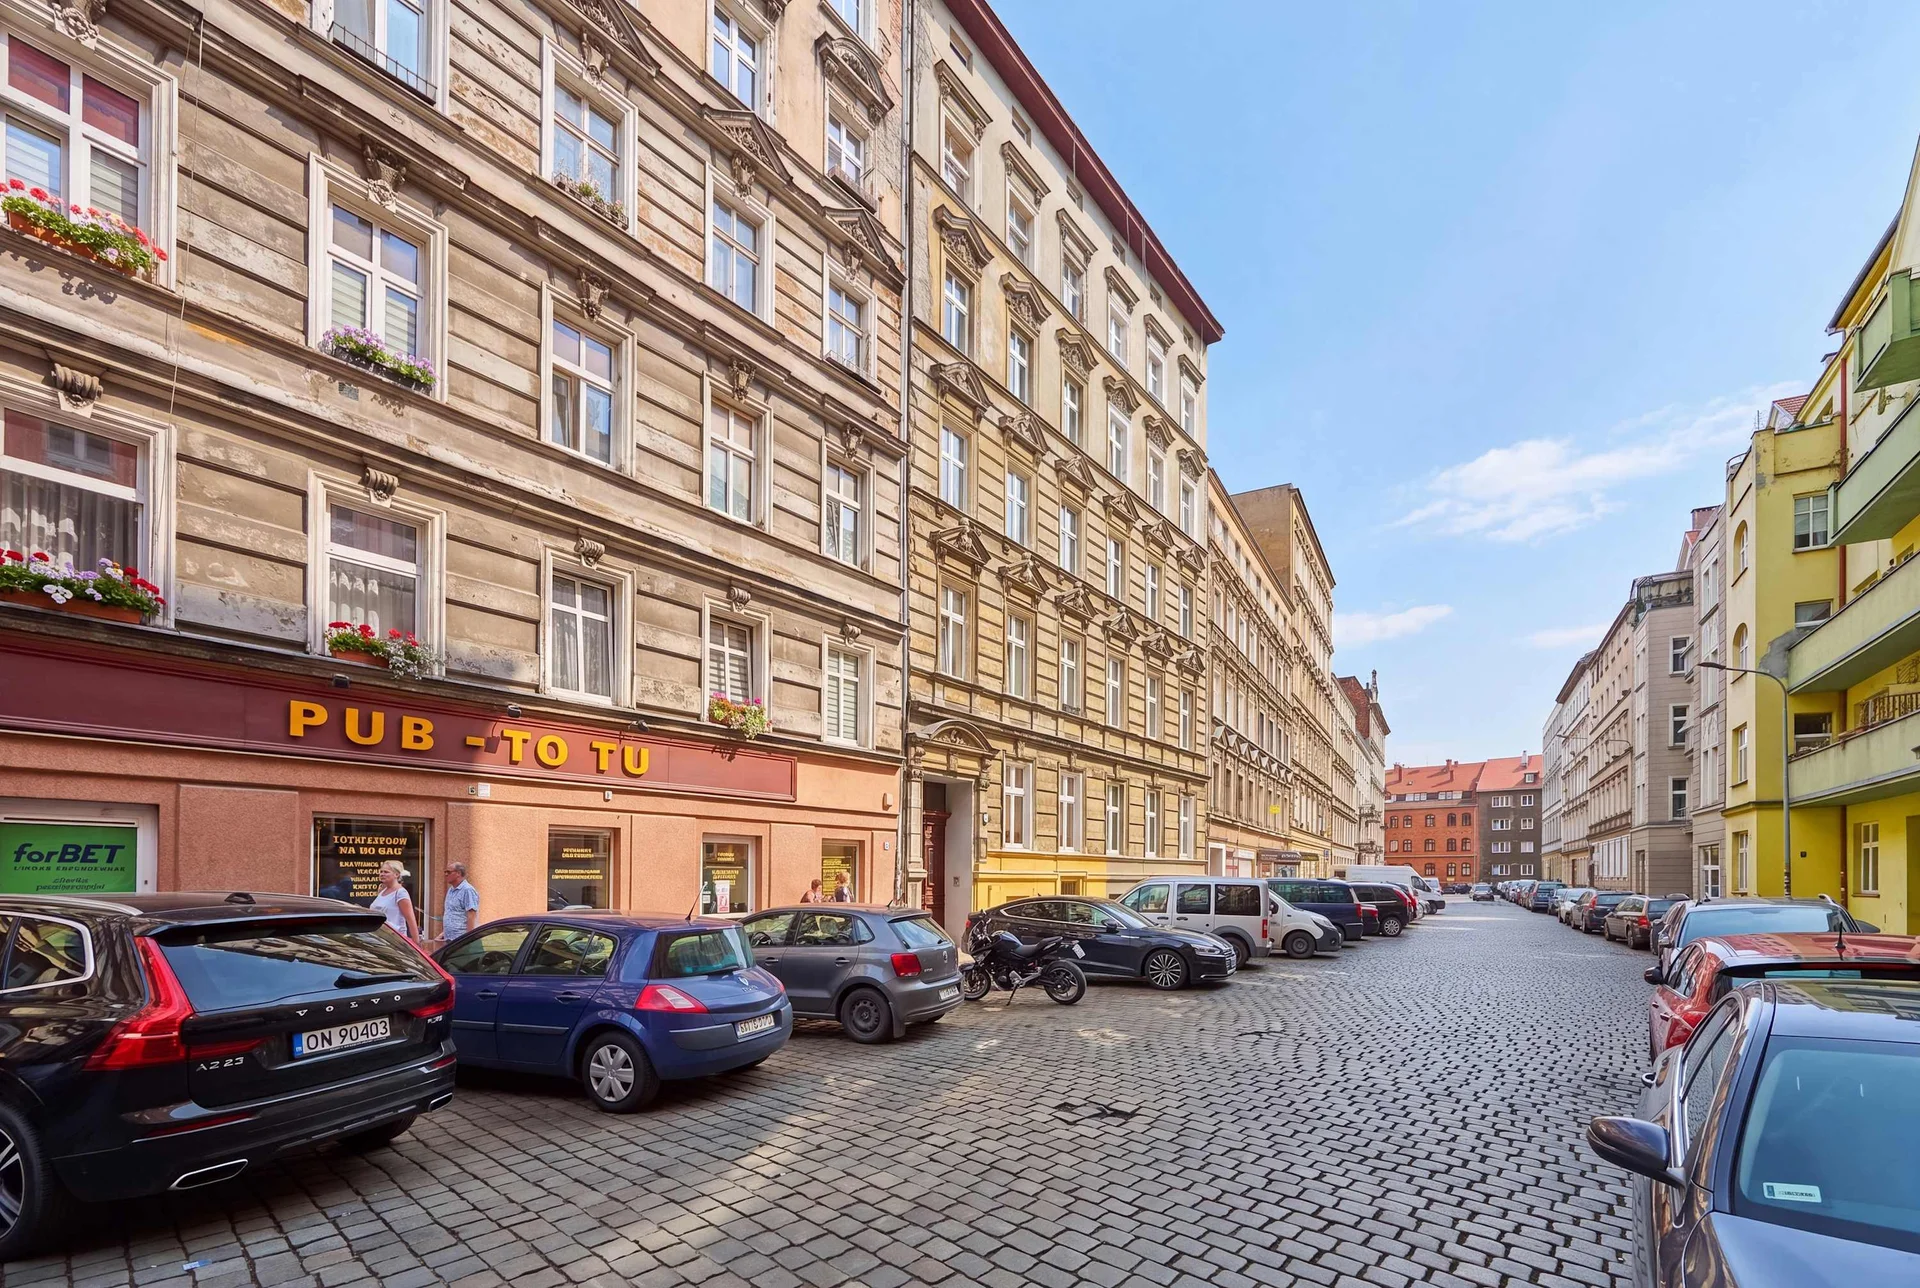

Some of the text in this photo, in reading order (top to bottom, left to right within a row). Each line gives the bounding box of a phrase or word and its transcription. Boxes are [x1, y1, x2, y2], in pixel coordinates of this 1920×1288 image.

[289, 700, 435, 751] PUB
[503, 729, 569, 766] TO
[590, 741, 650, 775] TU
[13, 843, 126, 864] forBET
[296, 994, 401, 1017] VOLVO
[306, 1030, 333, 1051] ON
[339, 1020, 389, 1045] 90403
